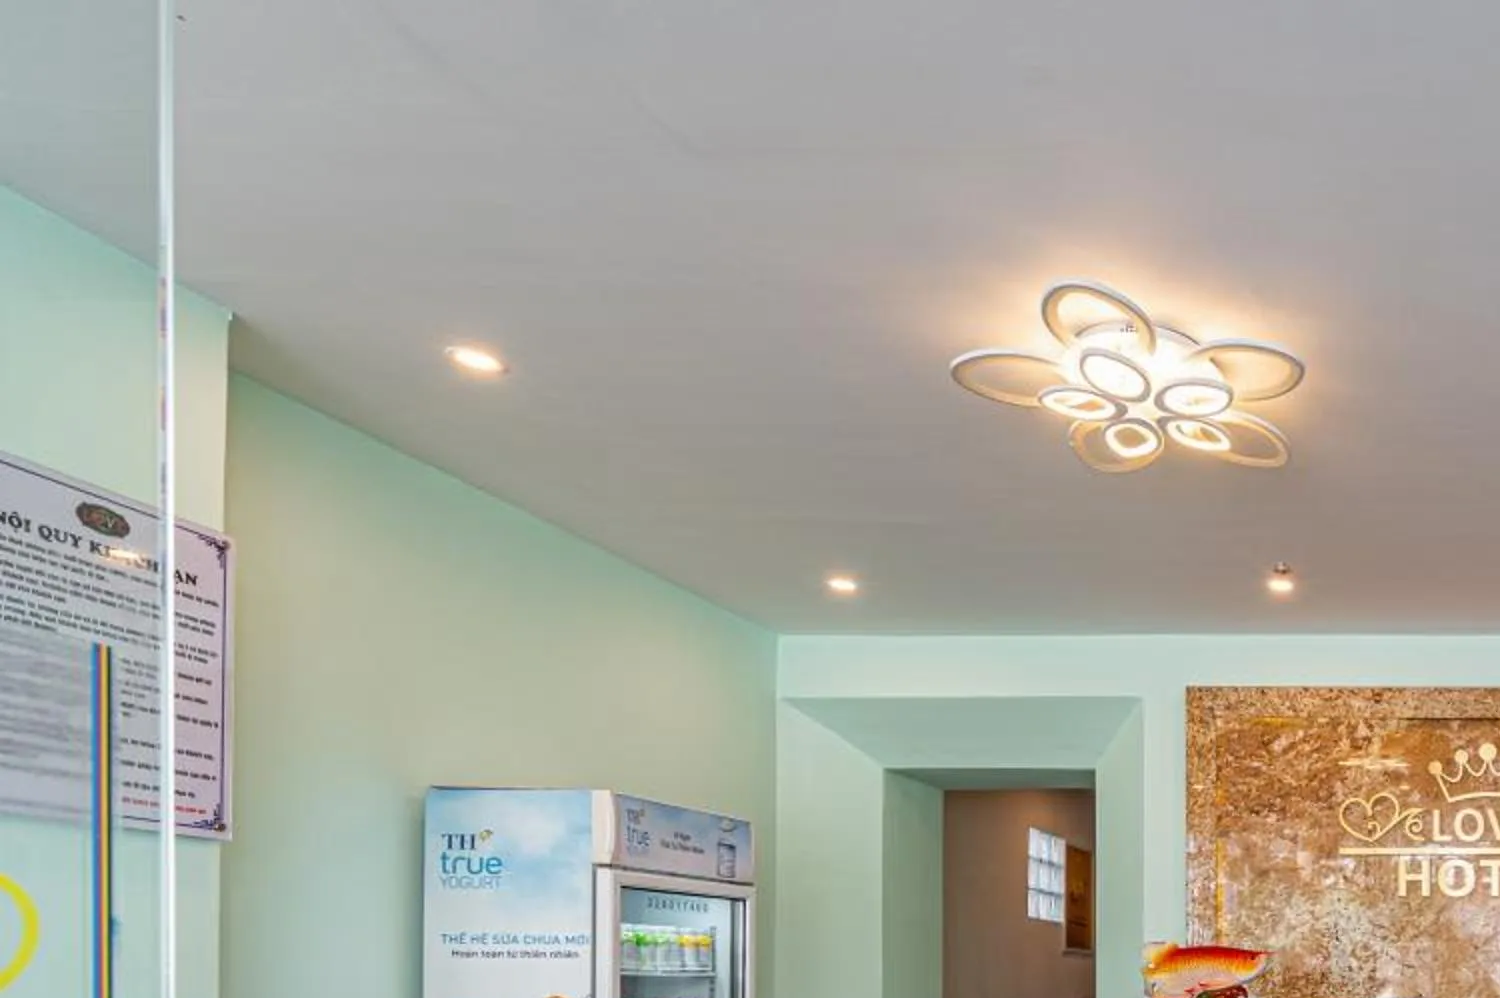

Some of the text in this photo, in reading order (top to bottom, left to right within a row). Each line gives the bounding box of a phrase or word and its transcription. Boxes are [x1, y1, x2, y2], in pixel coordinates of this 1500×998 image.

[38, 524, 82, 549] QUY
[441, 833, 477, 850] TH
[440, 851, 503, 875] true
[439, 875, 503, 890] YOGURT
